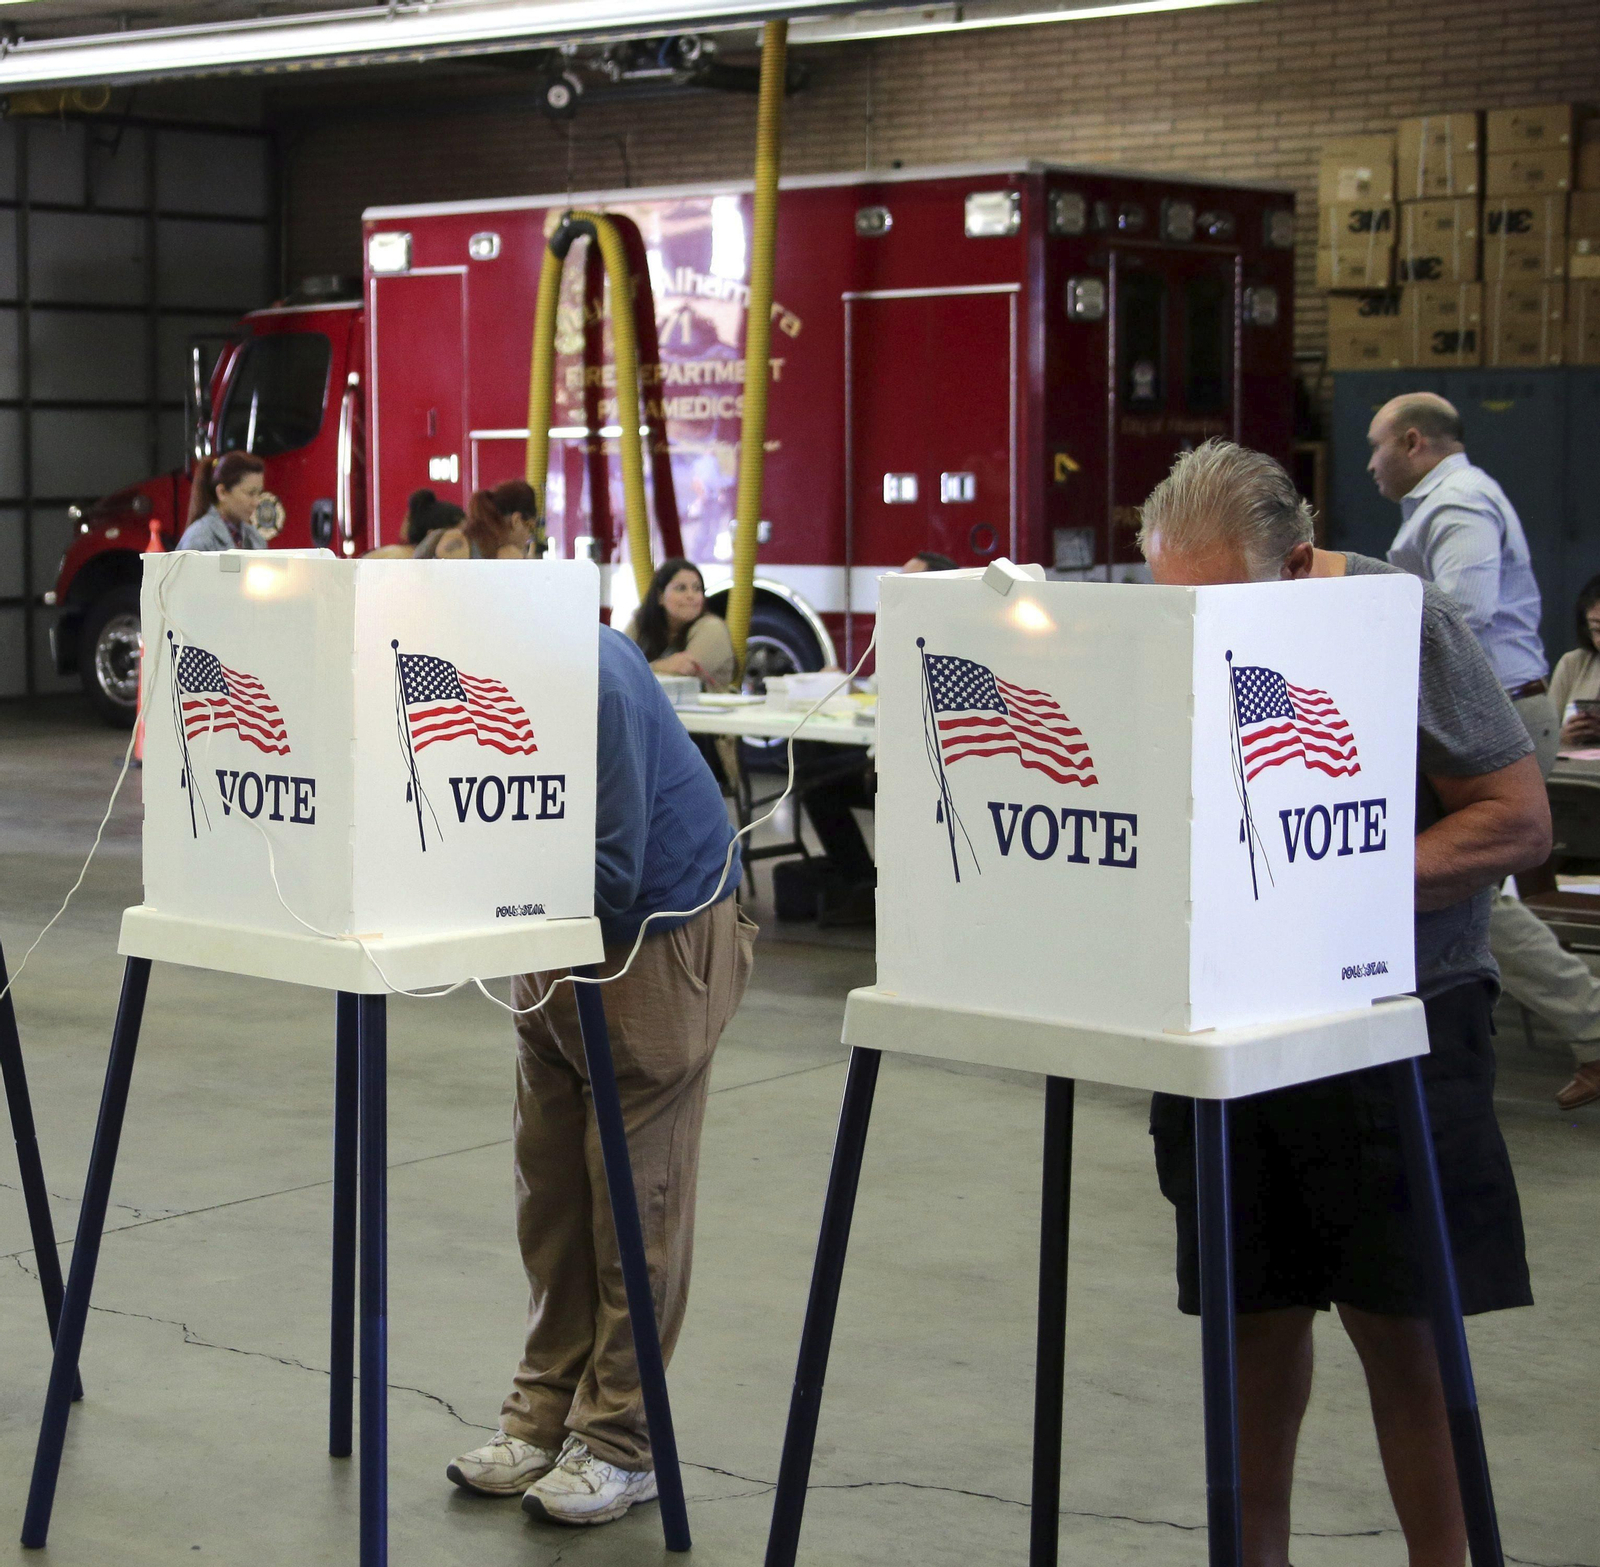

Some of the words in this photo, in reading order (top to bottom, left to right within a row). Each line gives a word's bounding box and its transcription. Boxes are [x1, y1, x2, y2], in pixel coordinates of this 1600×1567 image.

[1349, 209, 1390, 232] 3M
[1432, 330, 1476, 355] 3M
[215, 769, 316, 825] VOTE
[448, 774, 566, 823] VOTE
[987, 801, 1138, 869] VOTE
[1278, 797, 1387, 863] VOTE
